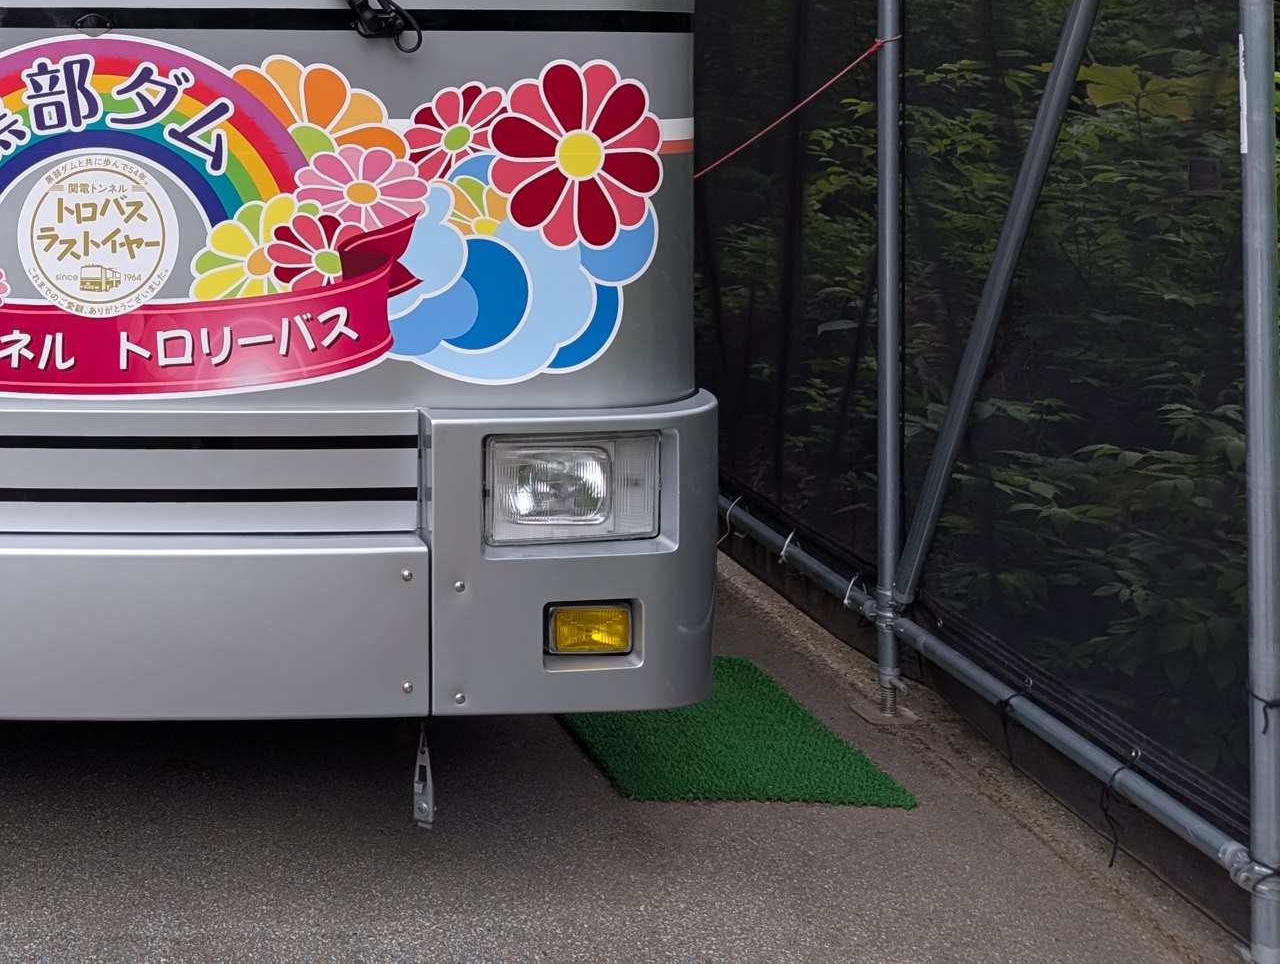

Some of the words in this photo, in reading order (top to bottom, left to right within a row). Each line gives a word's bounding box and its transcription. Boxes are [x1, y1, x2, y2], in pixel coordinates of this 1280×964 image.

[68, 183, 128, 194] 関電トンネル
[56, 194, 149, 224] トロバス
[36, 226, 161, 262] ラストイヤー
[55, 272, 79, 281] since
[123, 273, 142, 282] 1964
[119, 307, 360, 370] トロリーバス
